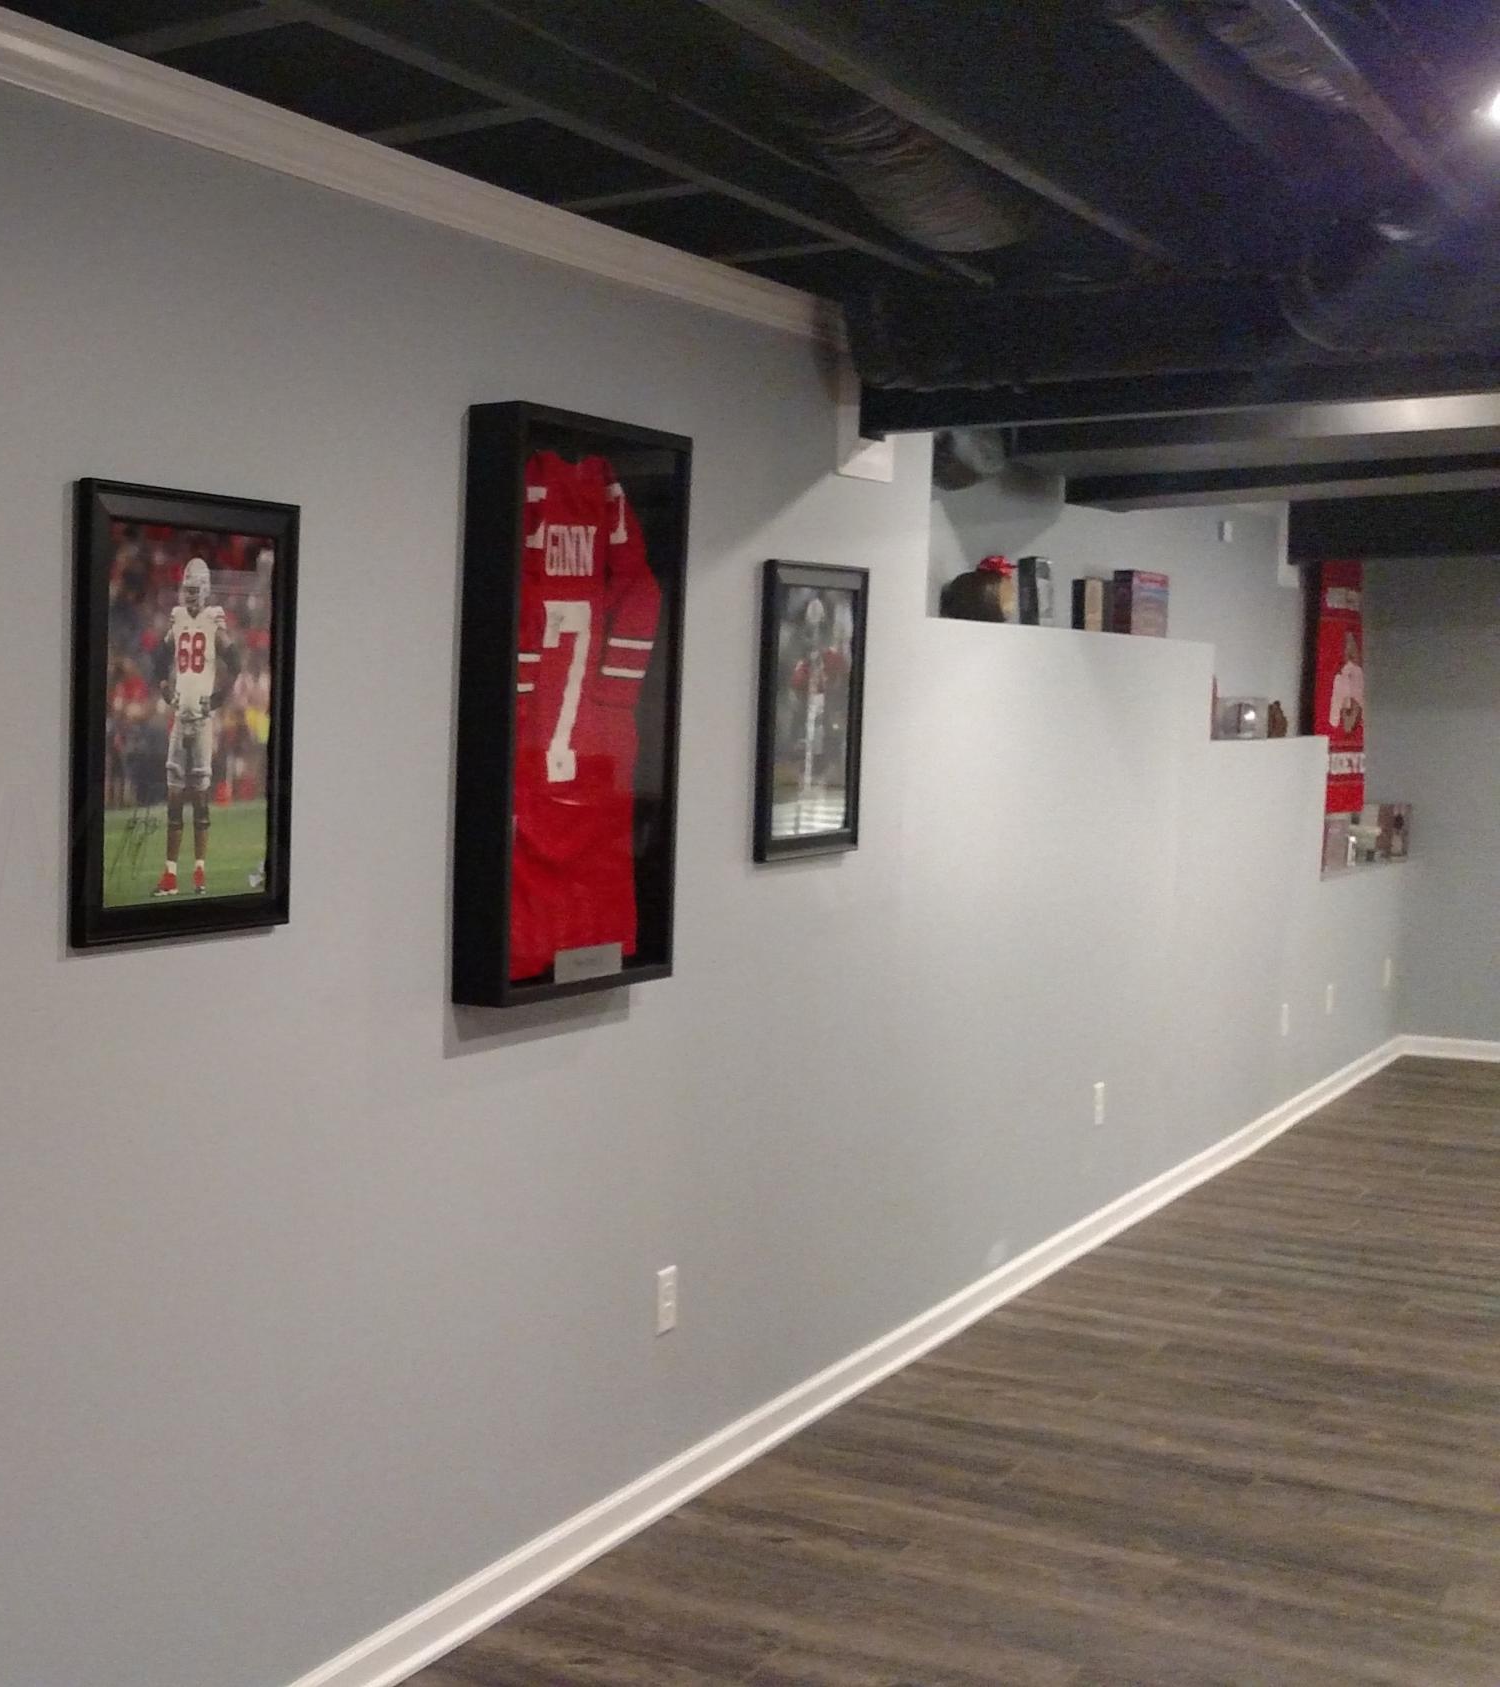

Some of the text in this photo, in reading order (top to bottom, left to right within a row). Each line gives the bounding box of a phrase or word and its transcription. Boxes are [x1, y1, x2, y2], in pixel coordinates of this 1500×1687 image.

[545, 524, 597, 576] GINN
[178, 631, 206, 674] 68
[543, 600, 591, 782] 7
